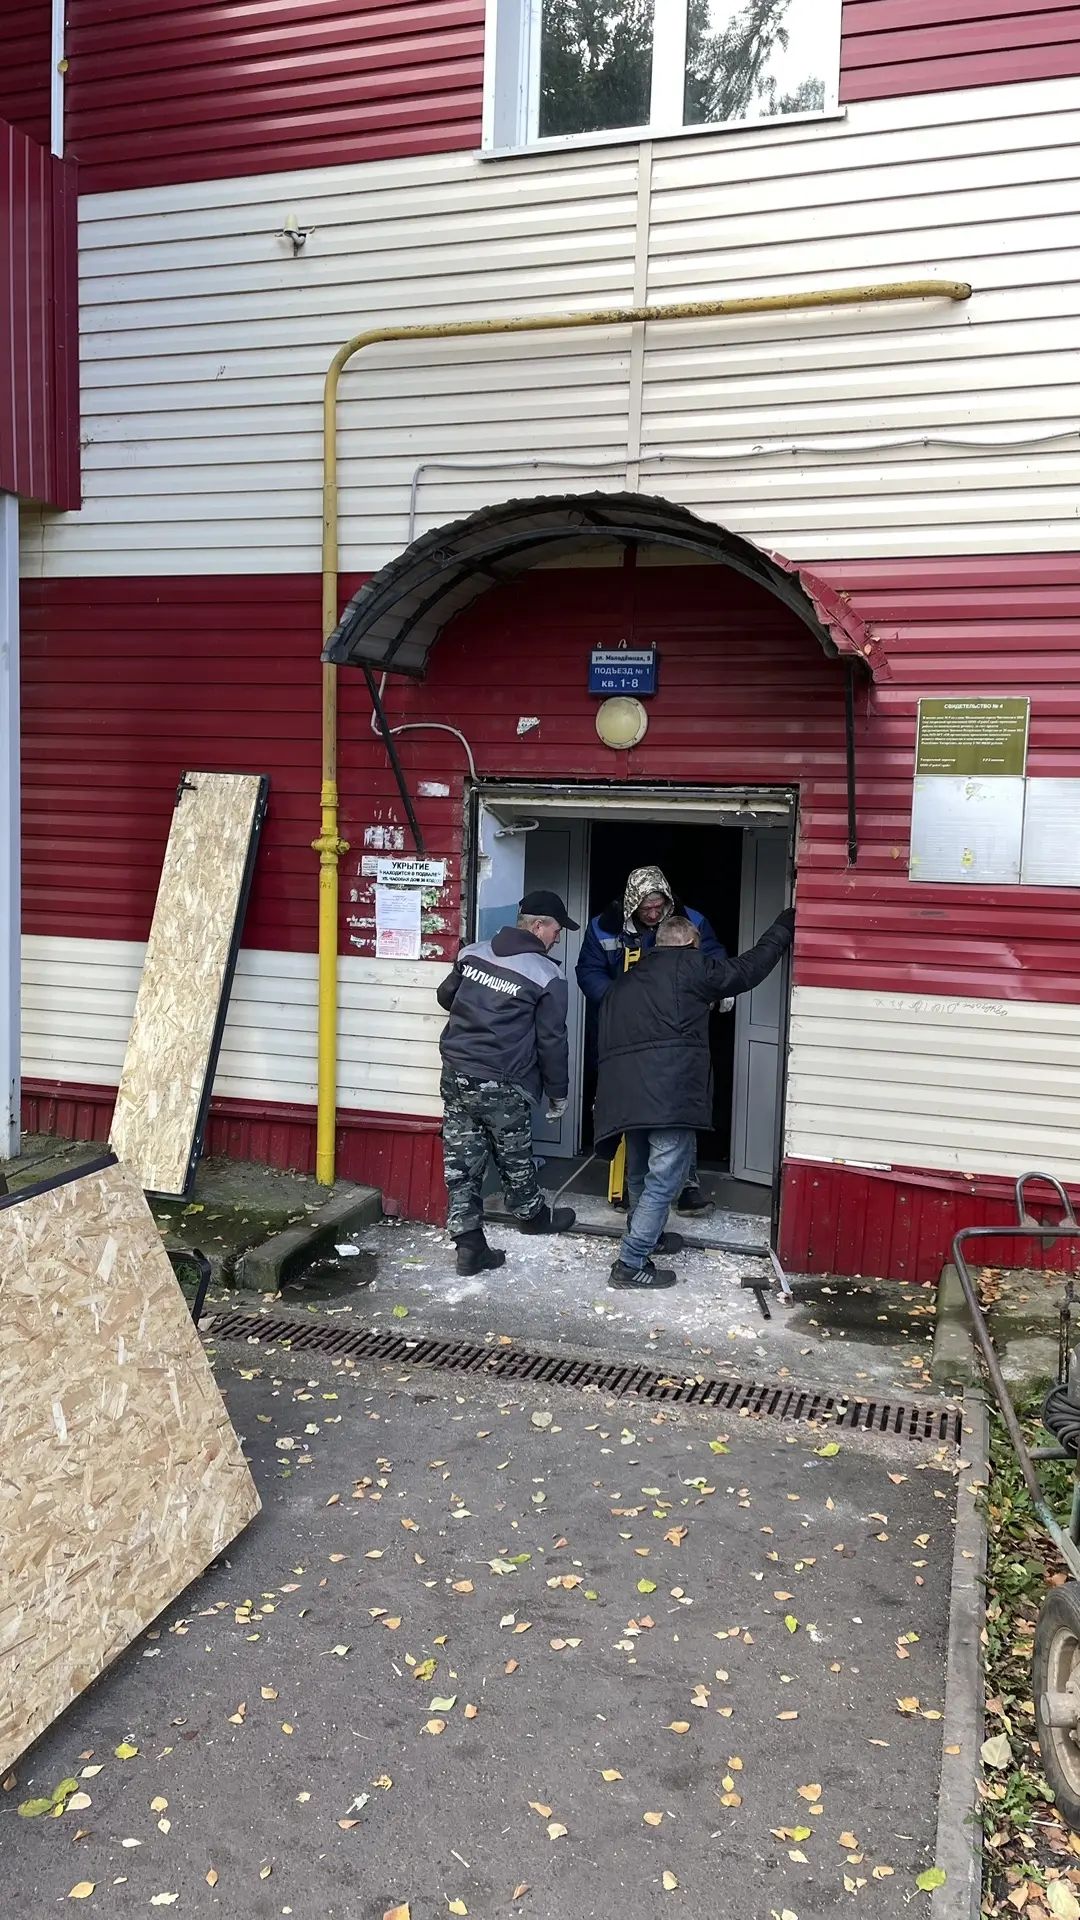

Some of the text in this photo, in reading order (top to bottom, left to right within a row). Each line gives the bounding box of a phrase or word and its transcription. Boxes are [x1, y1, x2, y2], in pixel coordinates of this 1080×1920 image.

[594, 667, 633, 675] ПОДЪЕЗД
[620, 678, 639, 688] 1-8
[392, 861, 430, 870] УКРЫТИЕ
